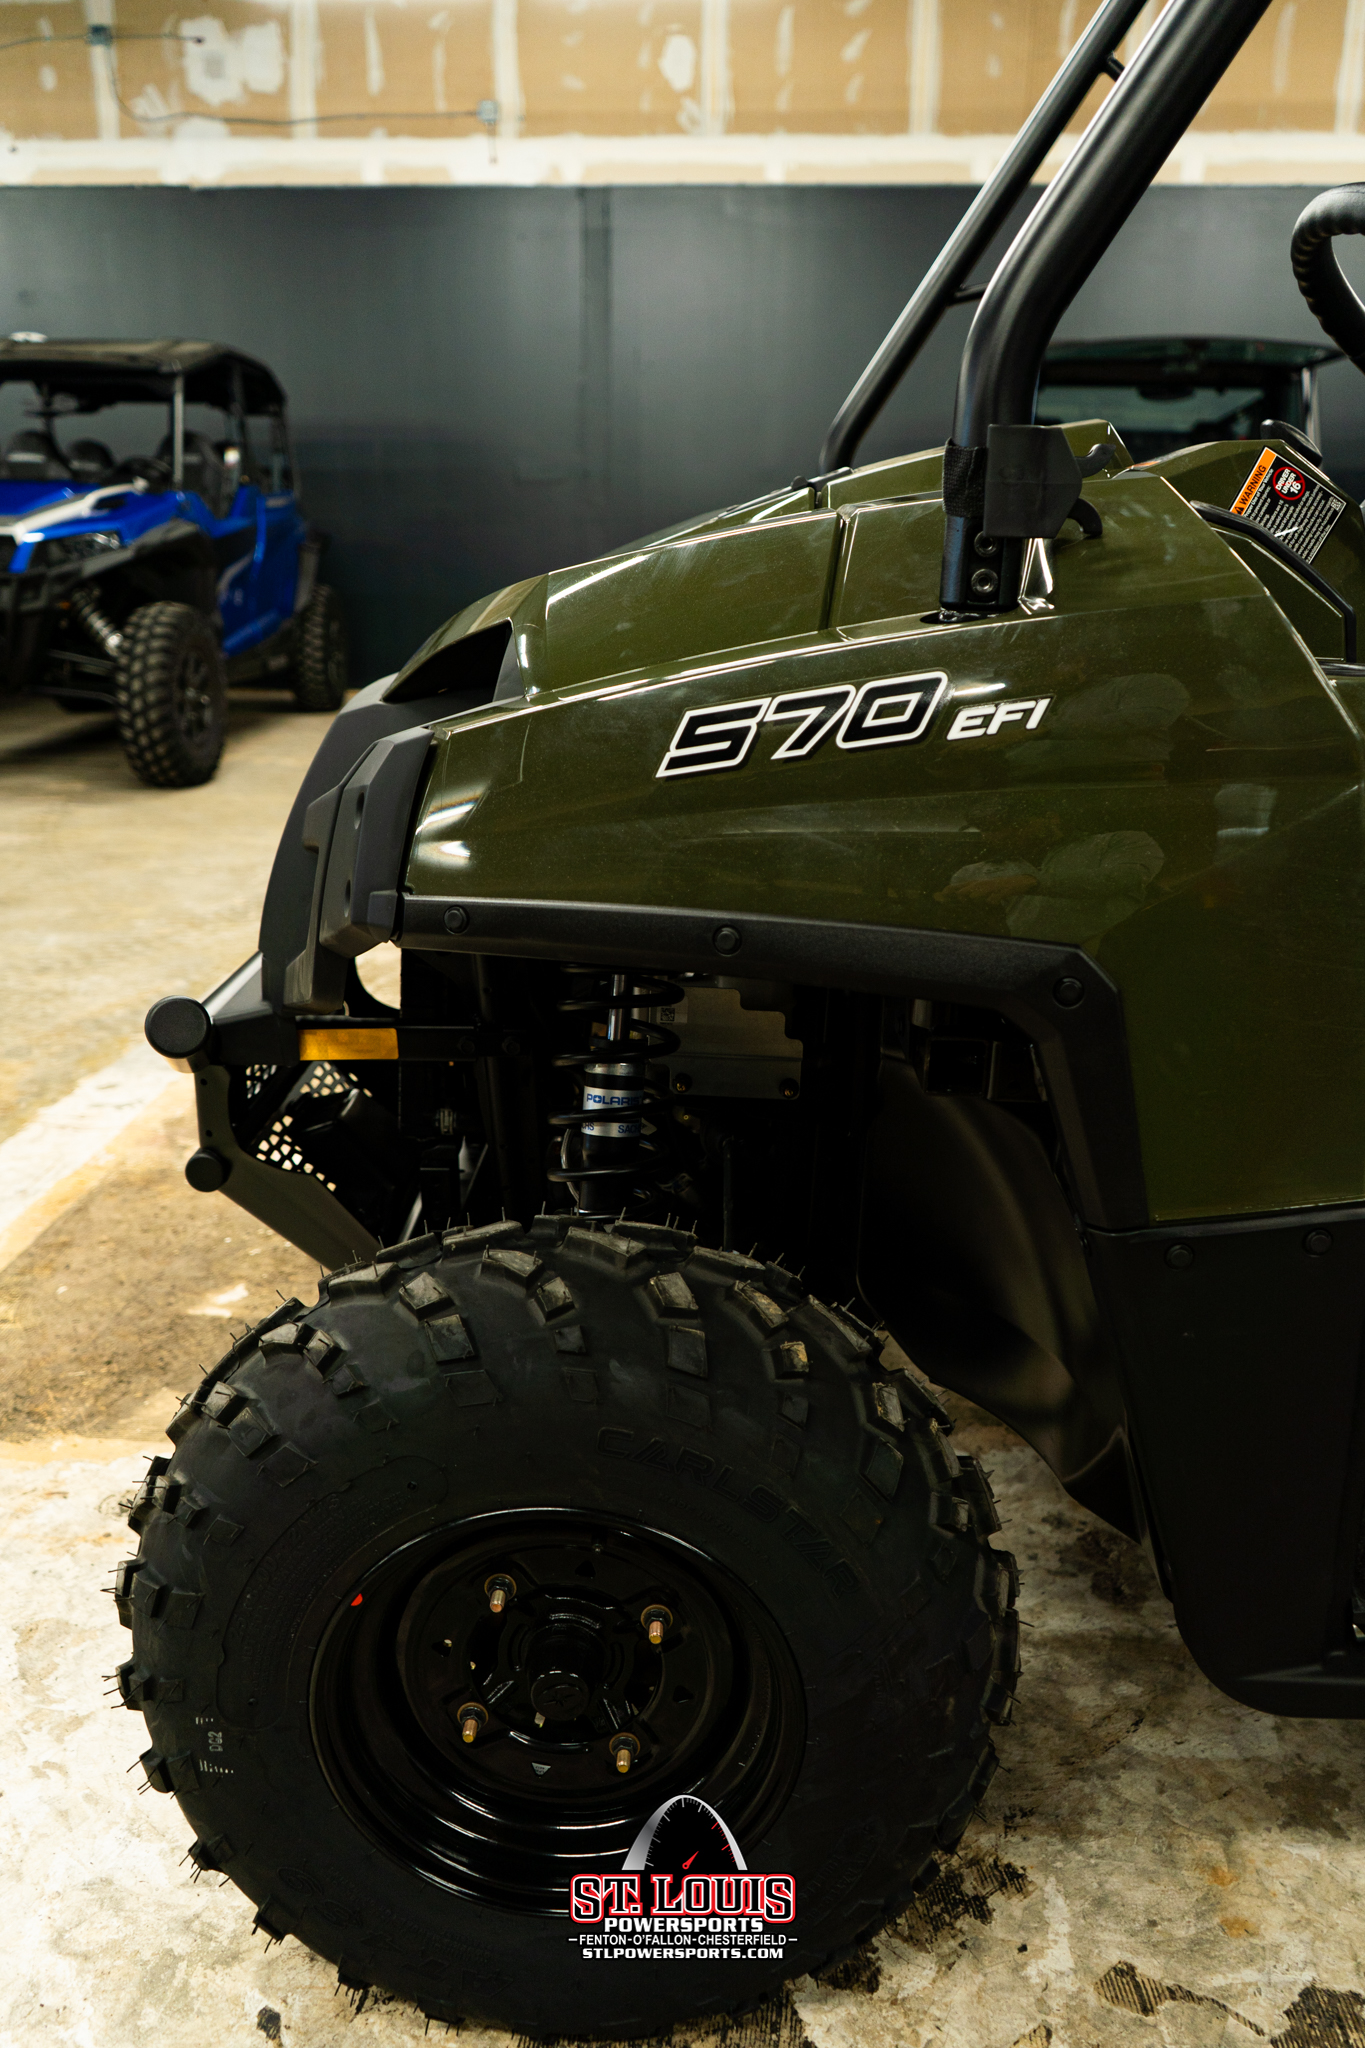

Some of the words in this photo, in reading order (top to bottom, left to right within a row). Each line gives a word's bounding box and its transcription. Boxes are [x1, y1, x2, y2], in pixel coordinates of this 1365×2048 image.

[1239, 464, 1267, 506] WARNING
[1274, 468, 1291, 490] DRIVER
[1280, 472, 1296, 494] UNDER
[1288, 480, 1302, 495] 16
[655, 670, 949, 778] 570
[946, 698, 1051, 740] EFI
[586, 1094, 640, 1106] POLARIS
